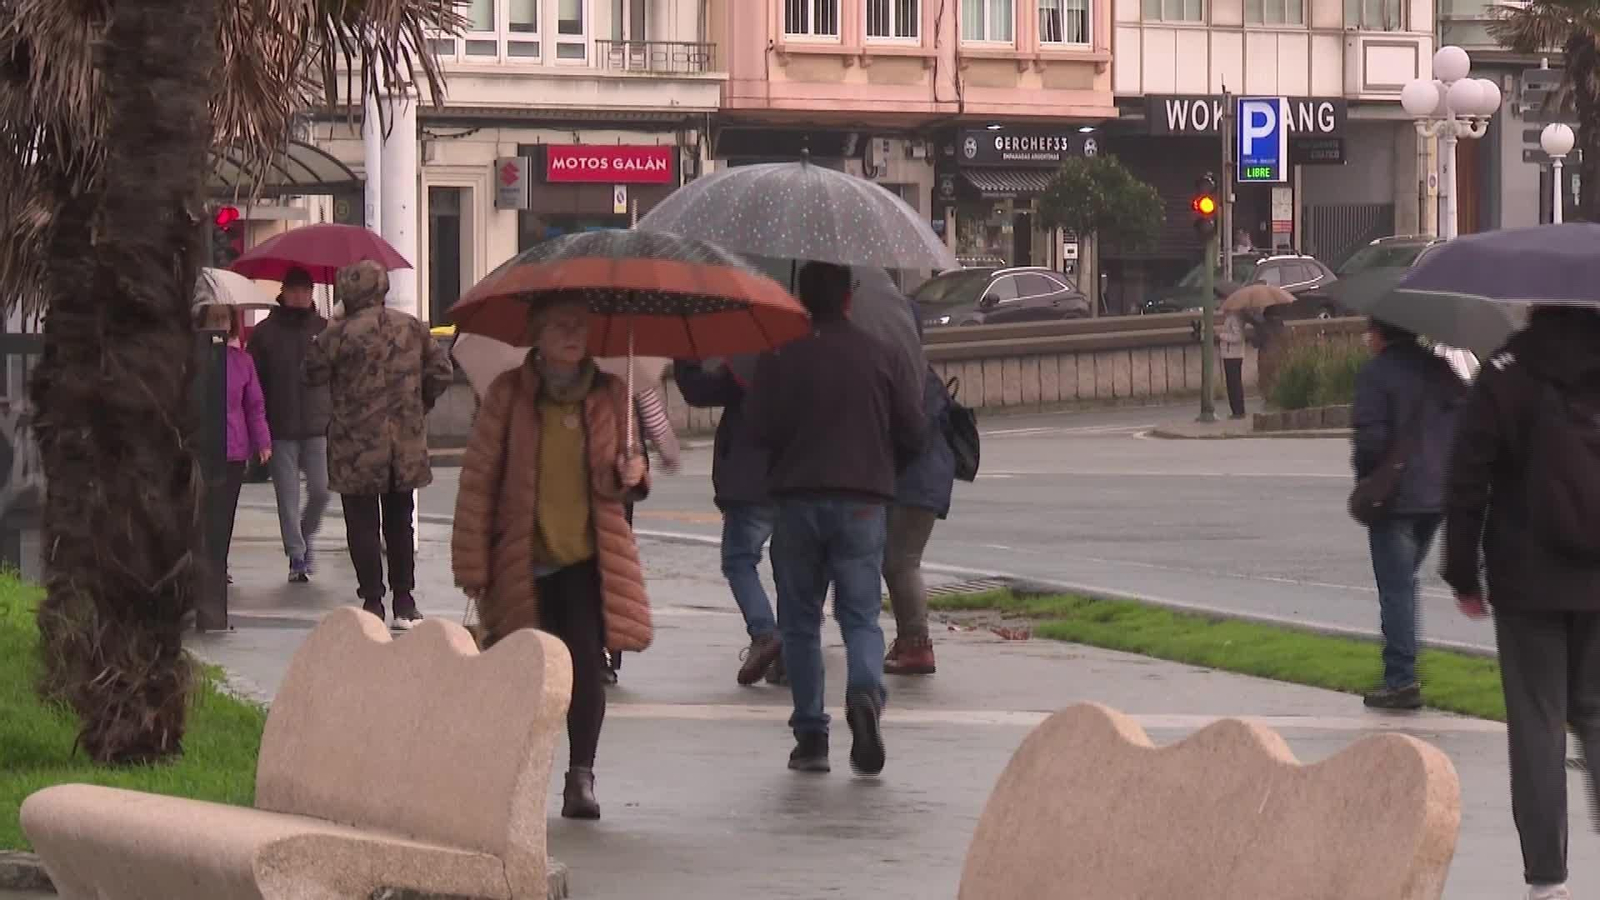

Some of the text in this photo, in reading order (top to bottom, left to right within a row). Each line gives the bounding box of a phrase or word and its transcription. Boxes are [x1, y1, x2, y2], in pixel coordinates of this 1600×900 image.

[1165, 99, 1224, 131] WOK
[1242, 101, 1277, 155] P
[994, 136, 1068, 151] GERCHEF33
[552, 156, 667, 170] MOTOS GALÁN
[1247, 167, 1271, 178] LIBRE
